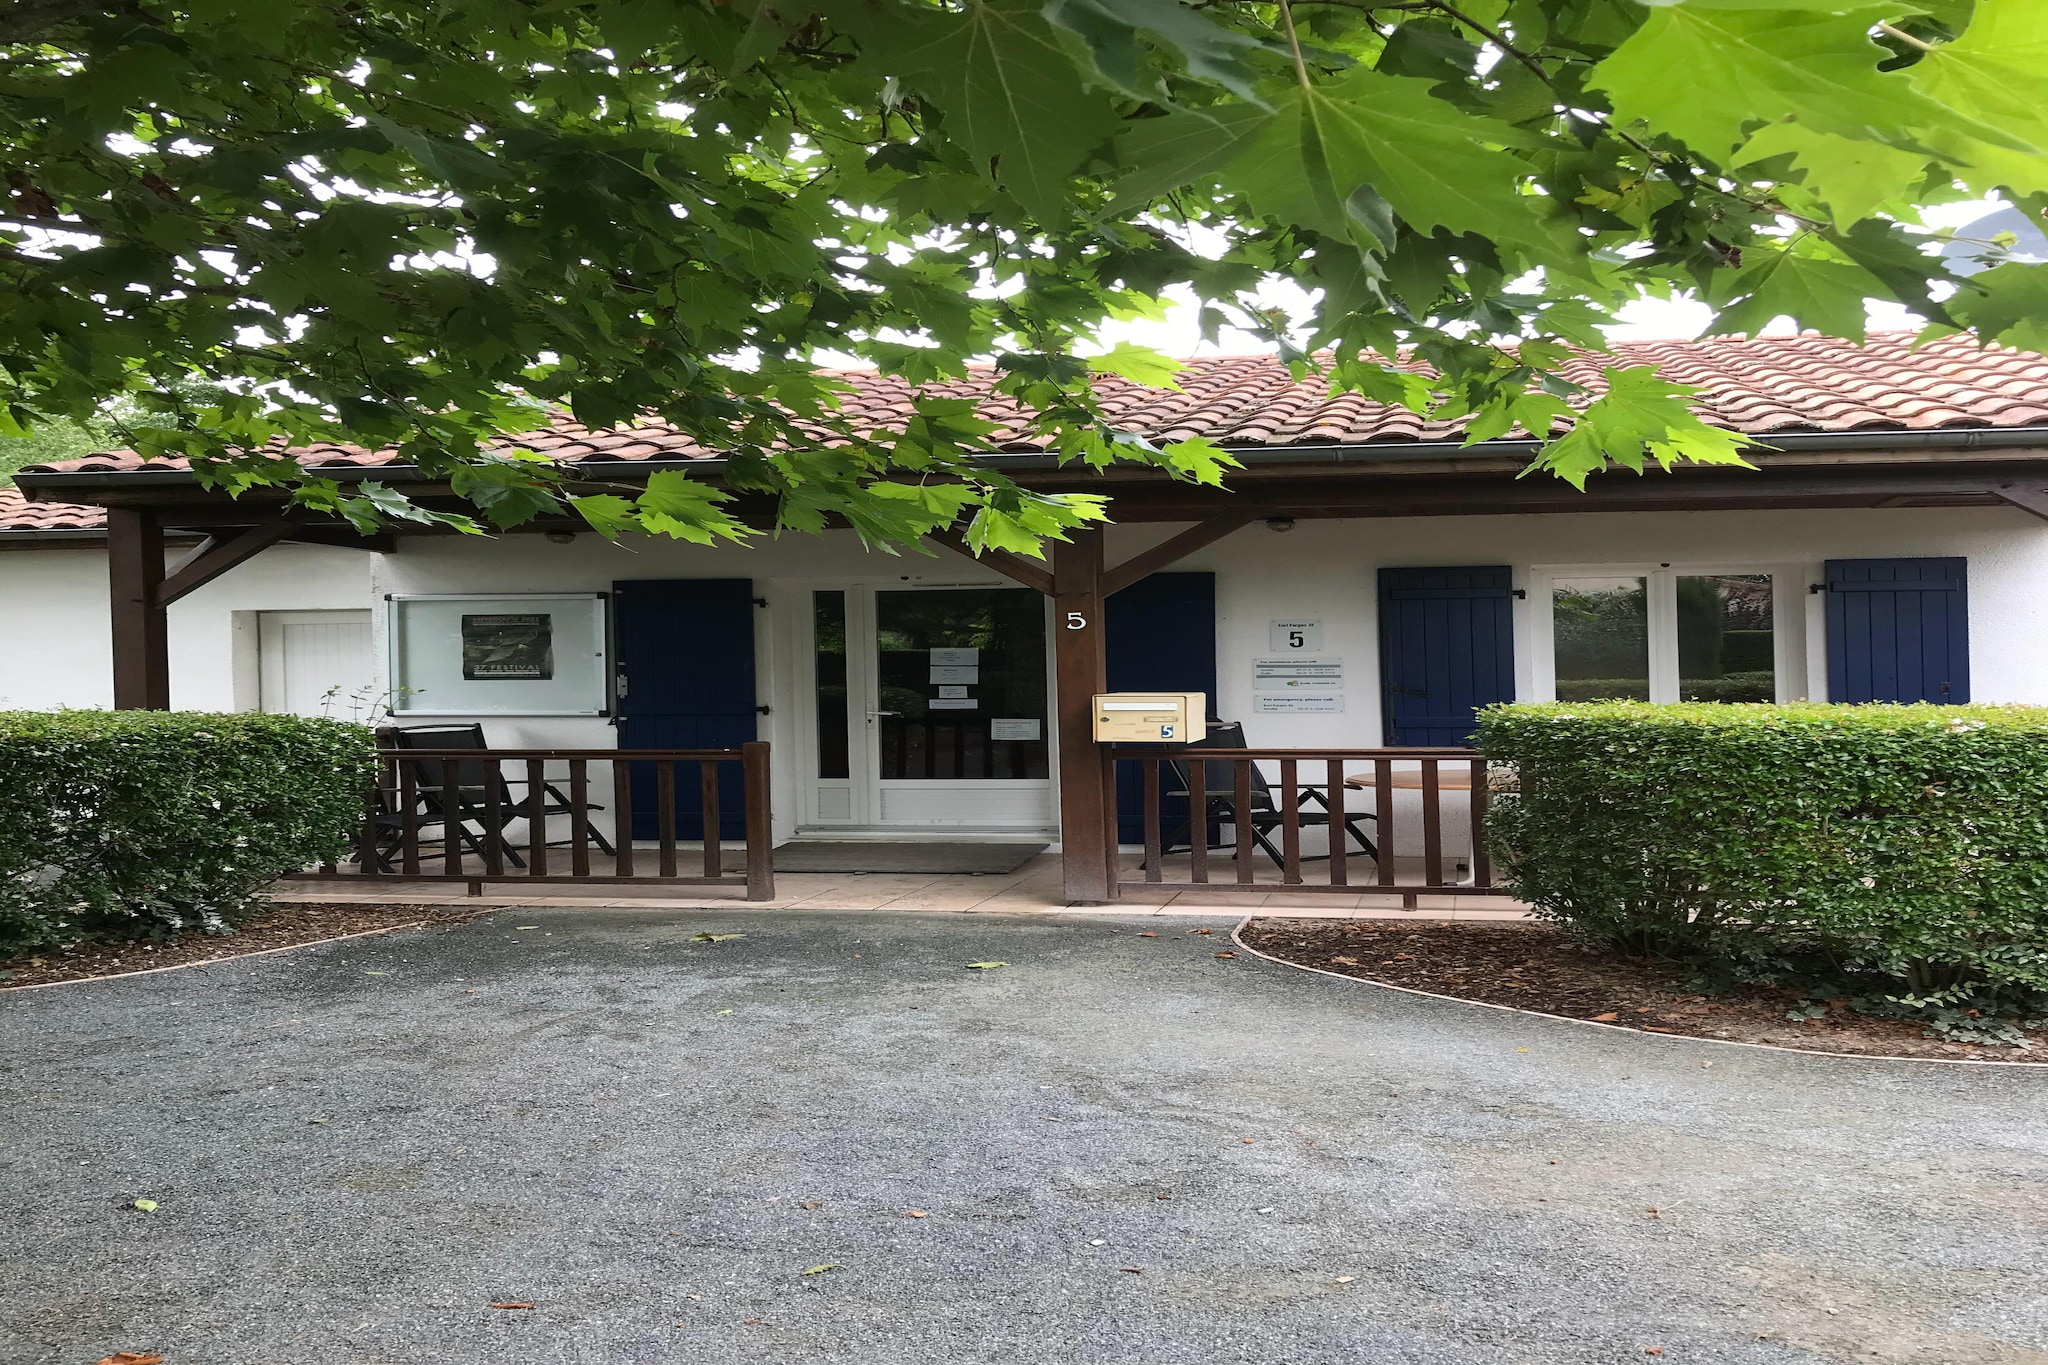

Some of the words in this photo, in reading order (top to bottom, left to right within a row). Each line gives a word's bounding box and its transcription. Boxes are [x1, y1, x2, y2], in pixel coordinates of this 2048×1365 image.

[1066, 612, 1087, 630] 5
[1290, 631, 1304, 647] 5
[1162, 726, 1173, 737] 5
